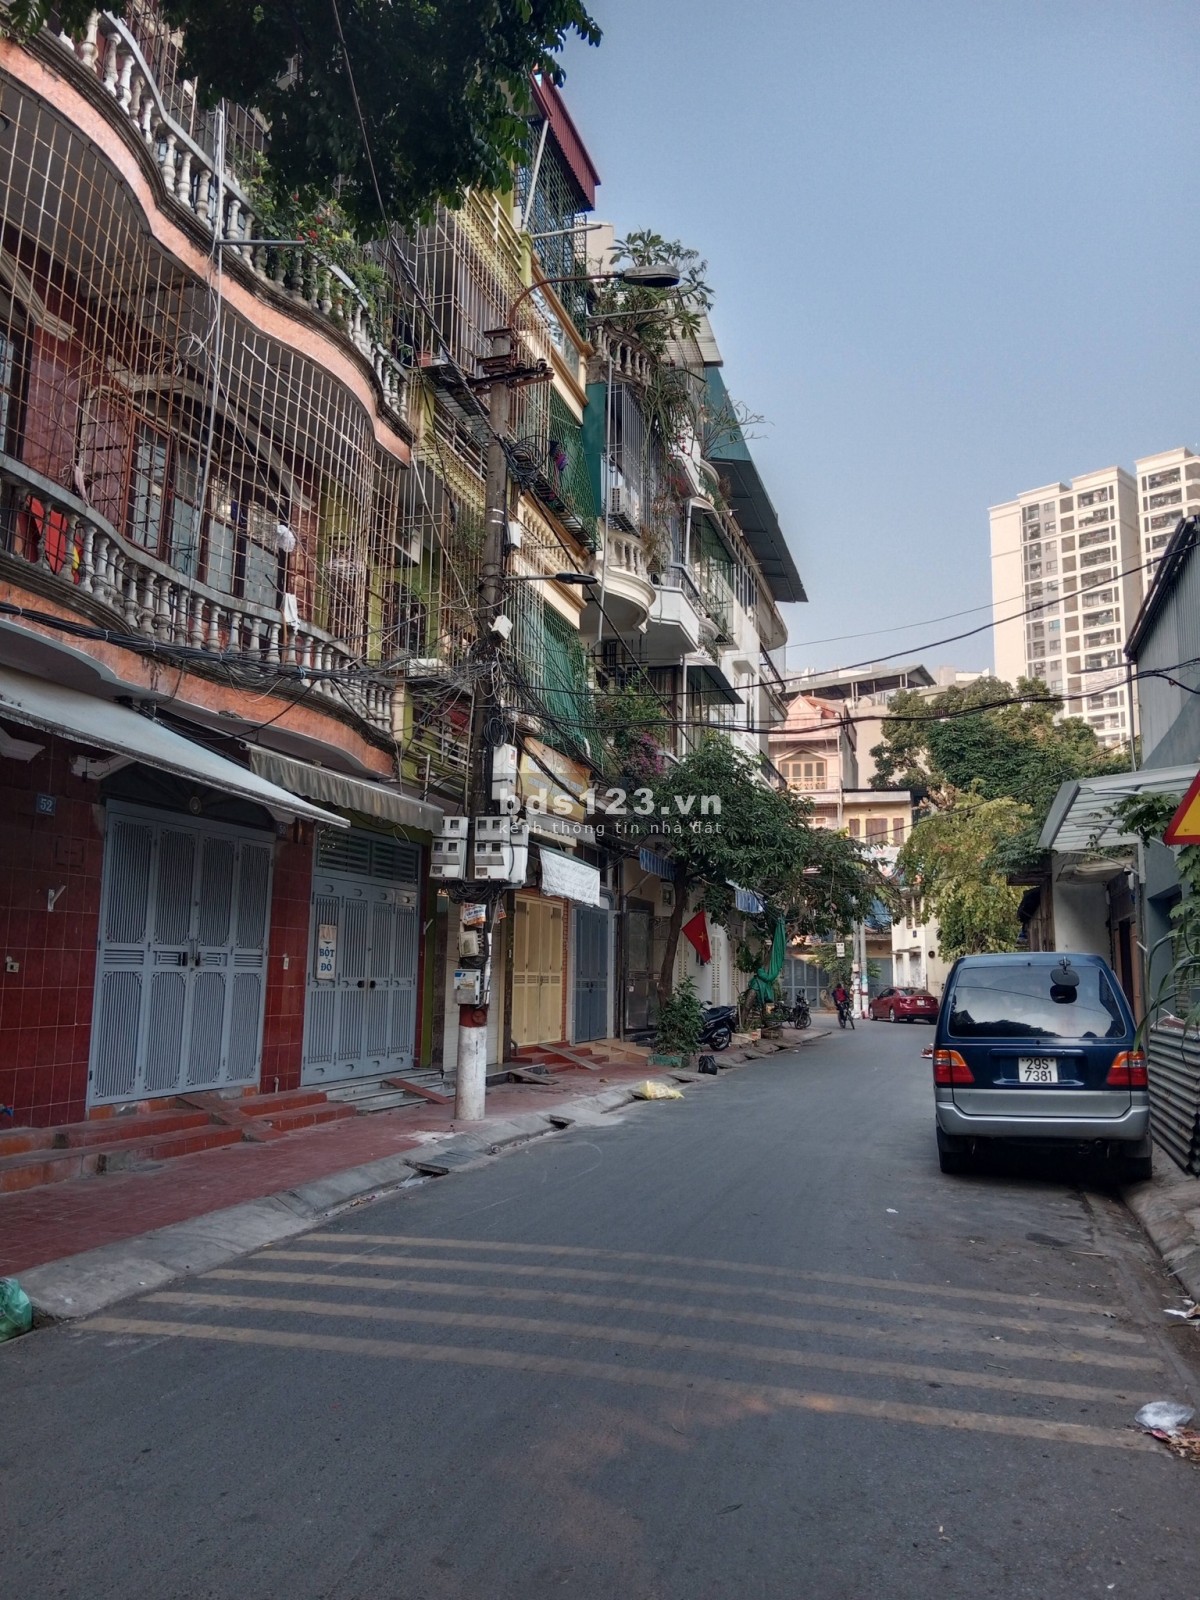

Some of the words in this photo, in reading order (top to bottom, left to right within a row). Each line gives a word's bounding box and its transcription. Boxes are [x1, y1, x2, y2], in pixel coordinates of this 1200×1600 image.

[41, 798, 52, 812] 52
[319, 946, 335, 960] BỘT
[320, 959, 333, 972] ĐỎ
[1026, 1057, 1049, 1070] 29S
[1025, 1070, 1052, 1082] 7381
